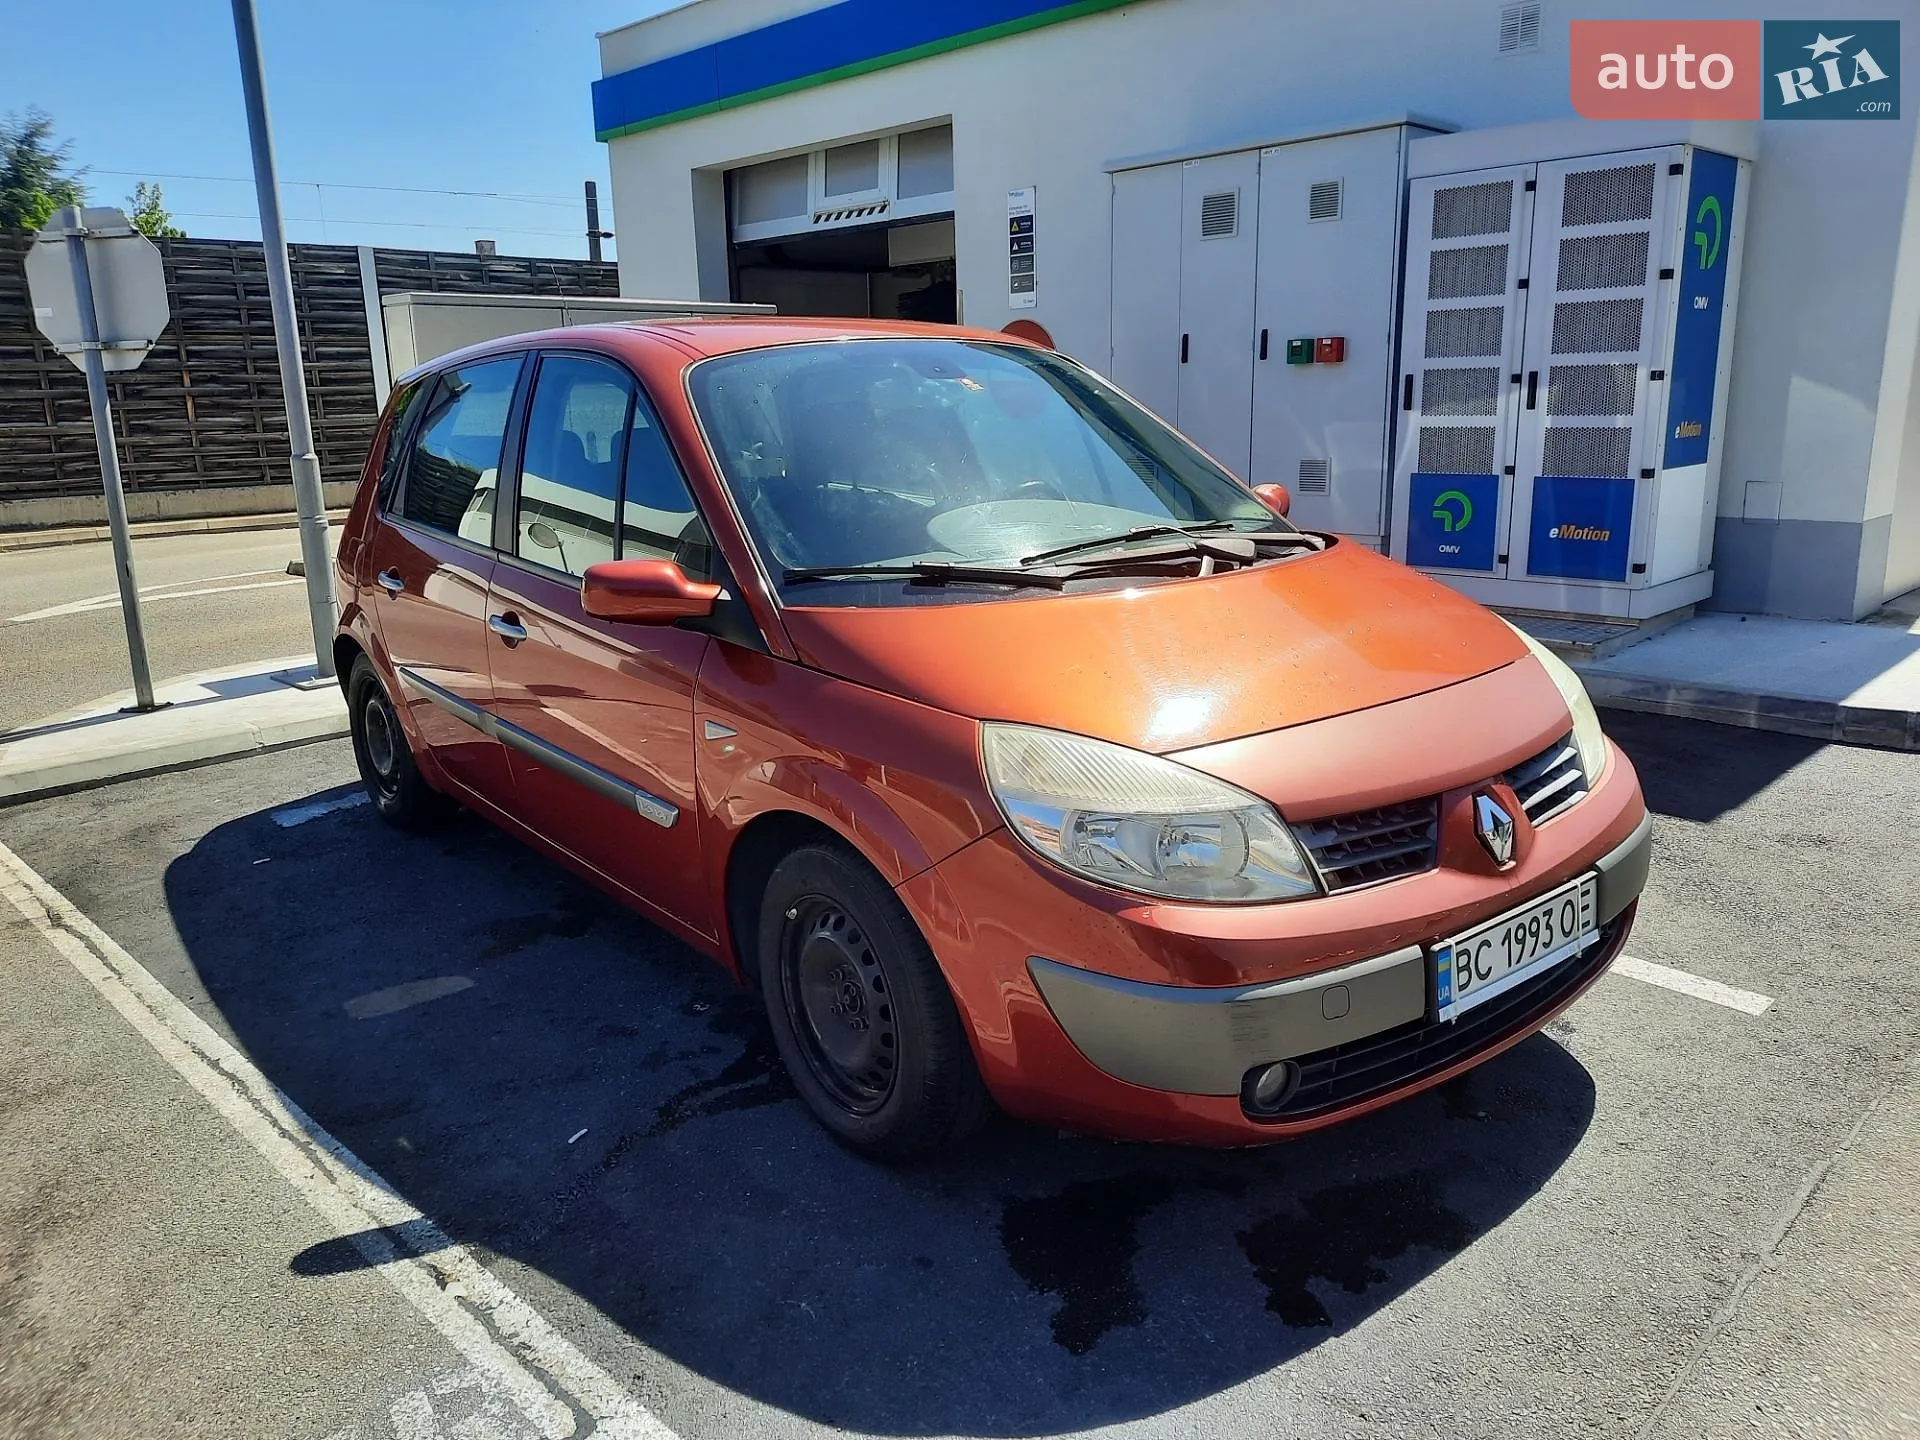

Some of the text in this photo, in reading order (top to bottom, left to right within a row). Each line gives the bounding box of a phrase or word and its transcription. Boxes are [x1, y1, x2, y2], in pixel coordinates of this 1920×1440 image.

[1693, 296, 1709, 310] OMV
[1674, 420, 1702, 439] eMotion
[1549, 524, 1611, 542] eMotion
[1438, 544, 1460, 554] OMV
[1455, 888, 1591, 992] BC 1993 OE
[1438, 986, 1450, 1000] UA
